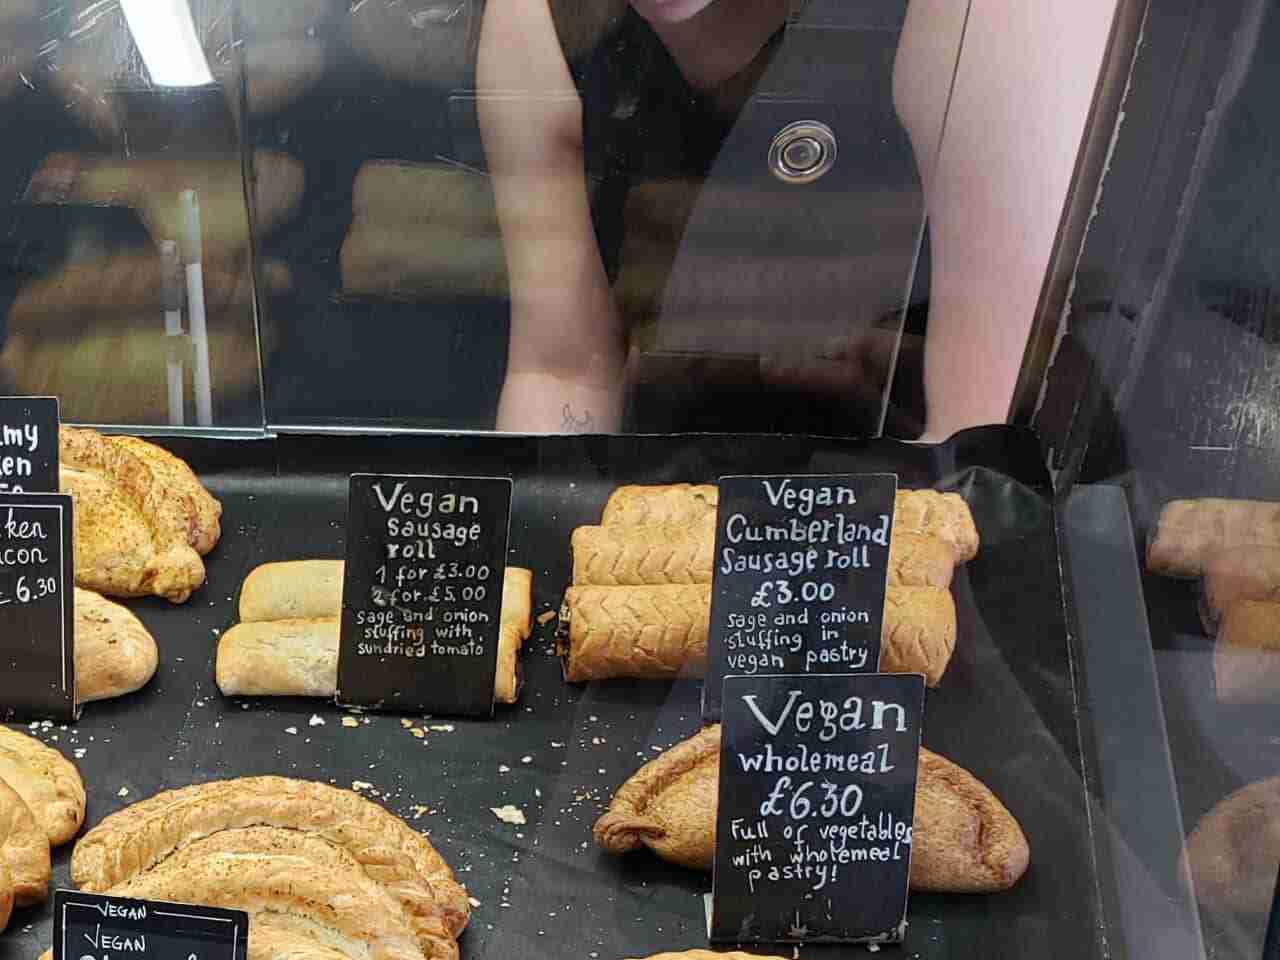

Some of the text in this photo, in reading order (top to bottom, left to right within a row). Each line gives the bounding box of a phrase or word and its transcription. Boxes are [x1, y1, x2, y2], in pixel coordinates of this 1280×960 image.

[372, 481, 479, 518] Vegan
[762, 479, 857, 516] Vegan
[387, 517, 481, 546] sausage
[726, 513, 890, 546] Cumberland
[386, 539, 436, 559] roll
[721, 545, 871, 575] Sausage roll
[375, 562, 490, 588] 1 for £3.00
[372, 588, 388, 606] 2
[389, 588, 422, 606] for
[751, 580, 835, 607] £3.00
[357, 607, 489, 625] sage and onion
[727, 607, 869, 632] sage and onion
[364, 624, 472, 646] stuffing with
[431, 641, 484, 656] tomato
[728, 625, 839, 652] stuffing in
[728, 641, 868, 674] vegan pastry
[741, 690, 908, 742] Vegan
[738, 744, 895, 773] wholemeal
[760, 776, 863, 820] £6.30
[731, 812, 913, 853] Full of vegetables
[732, 845, 771, 867] with
[748, 864, 837, 892] pastry!
[96, 901, 148, 919] VEGAN
[84, 923, 146, 952] VEGAN
